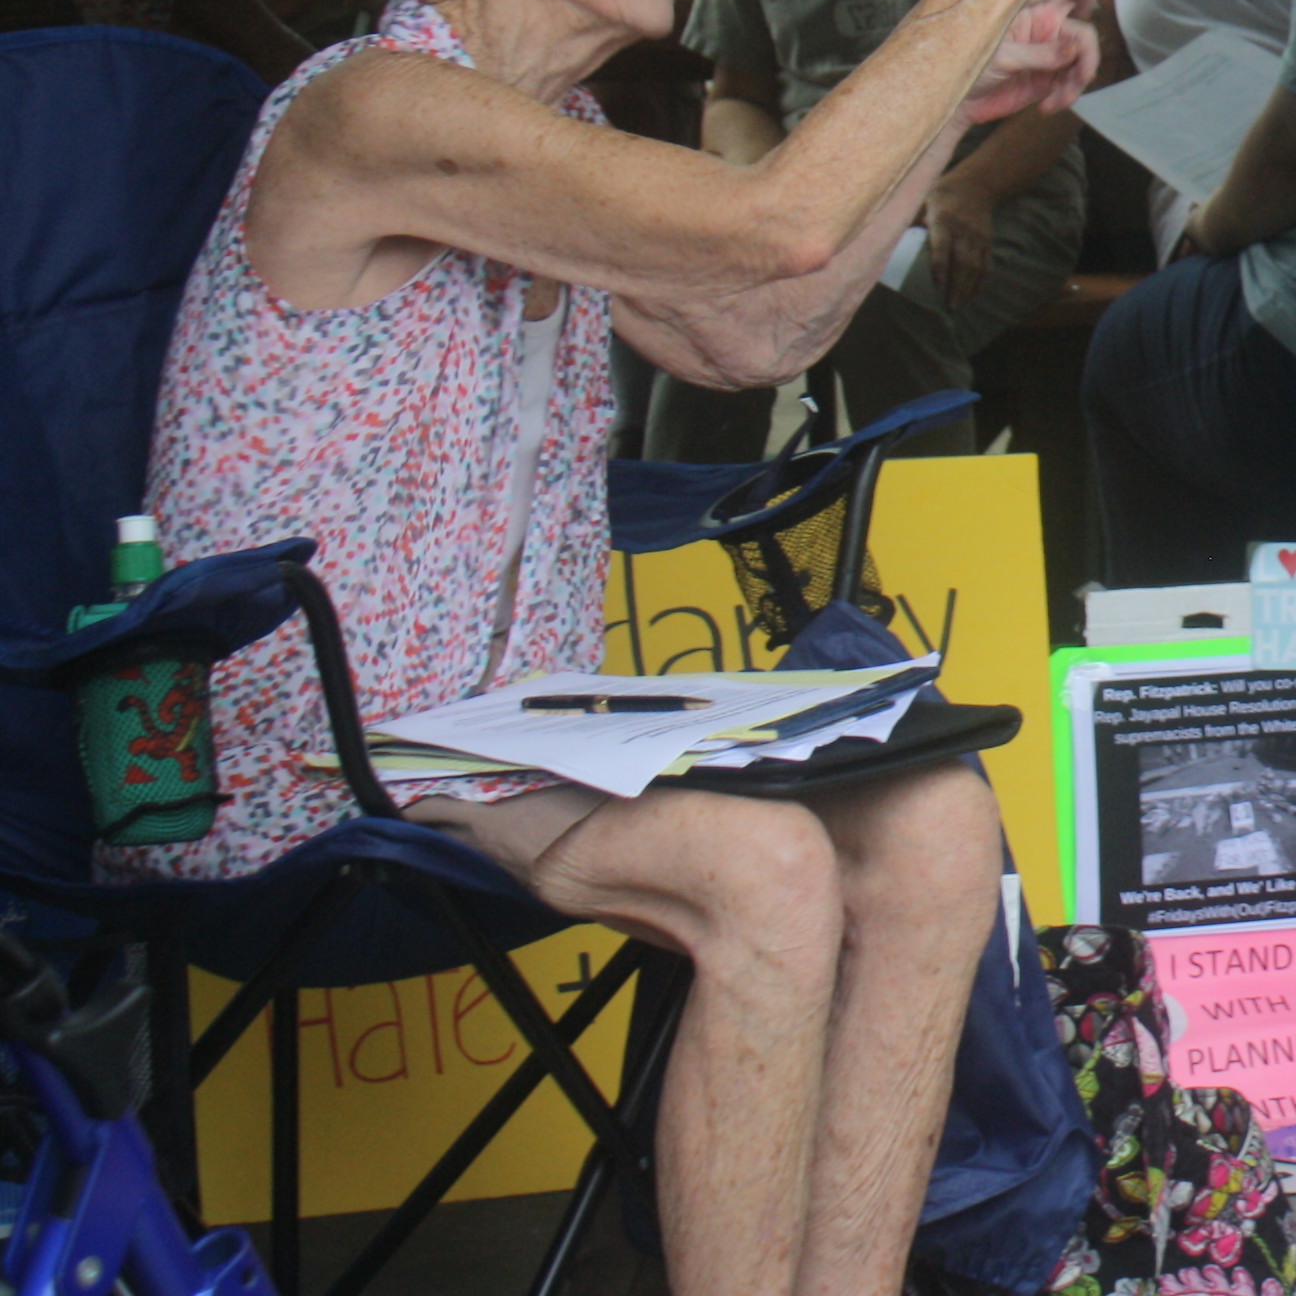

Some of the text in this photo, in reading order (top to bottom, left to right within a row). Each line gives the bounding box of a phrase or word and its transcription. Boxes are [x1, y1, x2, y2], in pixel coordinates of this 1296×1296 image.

[1102, 687, 1138, 703] Rep.
[1139, 682, 1219, 701] Fitzpatrick:
[1220, 678, 1246, 693] Will
[1247, 680, 1273, 695] you
[1128, 705, 1181, 723] Jayapal
[1182, 704, 1227, 718] House
[1114, 726, 1203, 746] supremacists
[1204, 723, 1237, 738] from
[1237, 721, 1260, 735] the
[1119, 889, 1162, 905] We're
[1163, 885, 1205, 901] Back,
[1206, 882, 1235, 897] and
[1264, 877, 1296, 893] Like
[1170, 954, 1178, 981] I
[1189, 942, 1294, 981] STAND
[1201, 994, 1292, 1021] WITH
